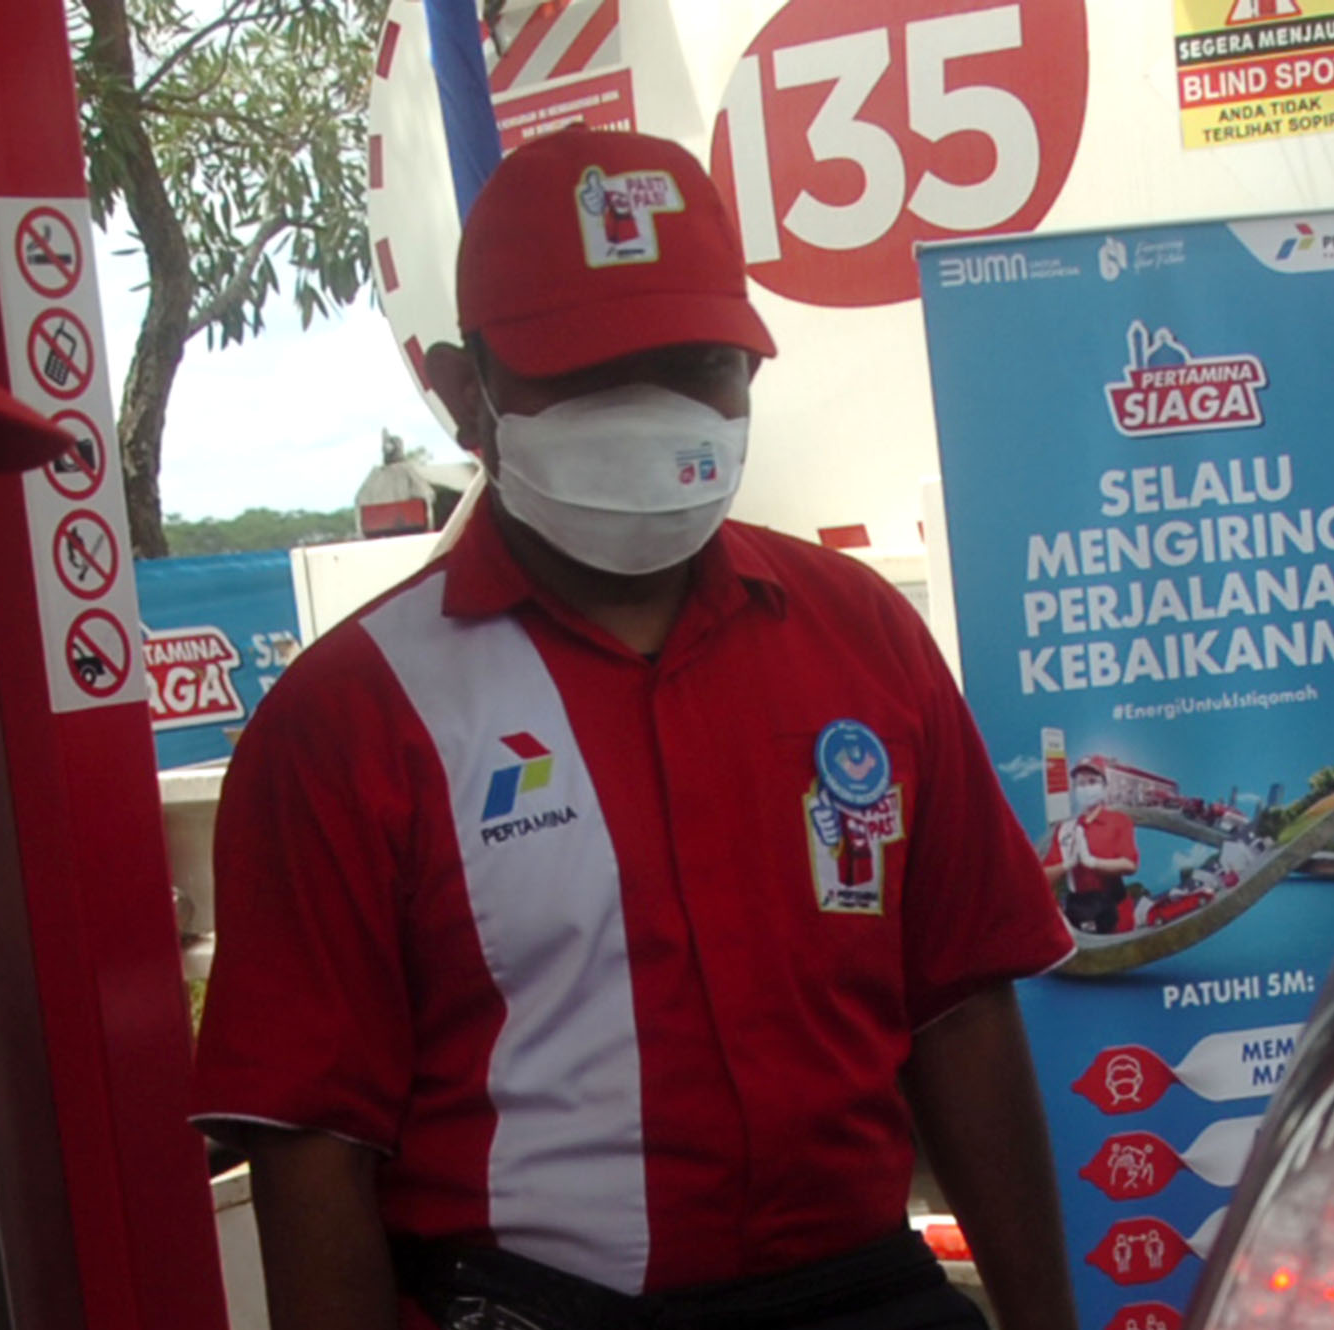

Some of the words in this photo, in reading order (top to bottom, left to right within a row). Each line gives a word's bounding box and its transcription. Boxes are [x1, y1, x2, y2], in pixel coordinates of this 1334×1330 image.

[1179, 33, 1255, 61] SEGERA
[1182, 66, 1268, 102] BLIND
[1218, 104, 1266, 122] ANDA
[1270, 96, 1322, 116] TIDAK
[718, 3, 1041, 264] 135
[1203, 119, 1283, 143] TERLIHAT
[1141, 362, 1253, 388] PERTAMINA
[1123, 384, 1250, 427] SIAGA
[1098, 455, 1293, 517] SELALU
[480, 806, 578, 846] PERTAMINA
[1162, 976, 1261, 1010] PATUHI
[1266, 969, 1315, 998] 5M:
